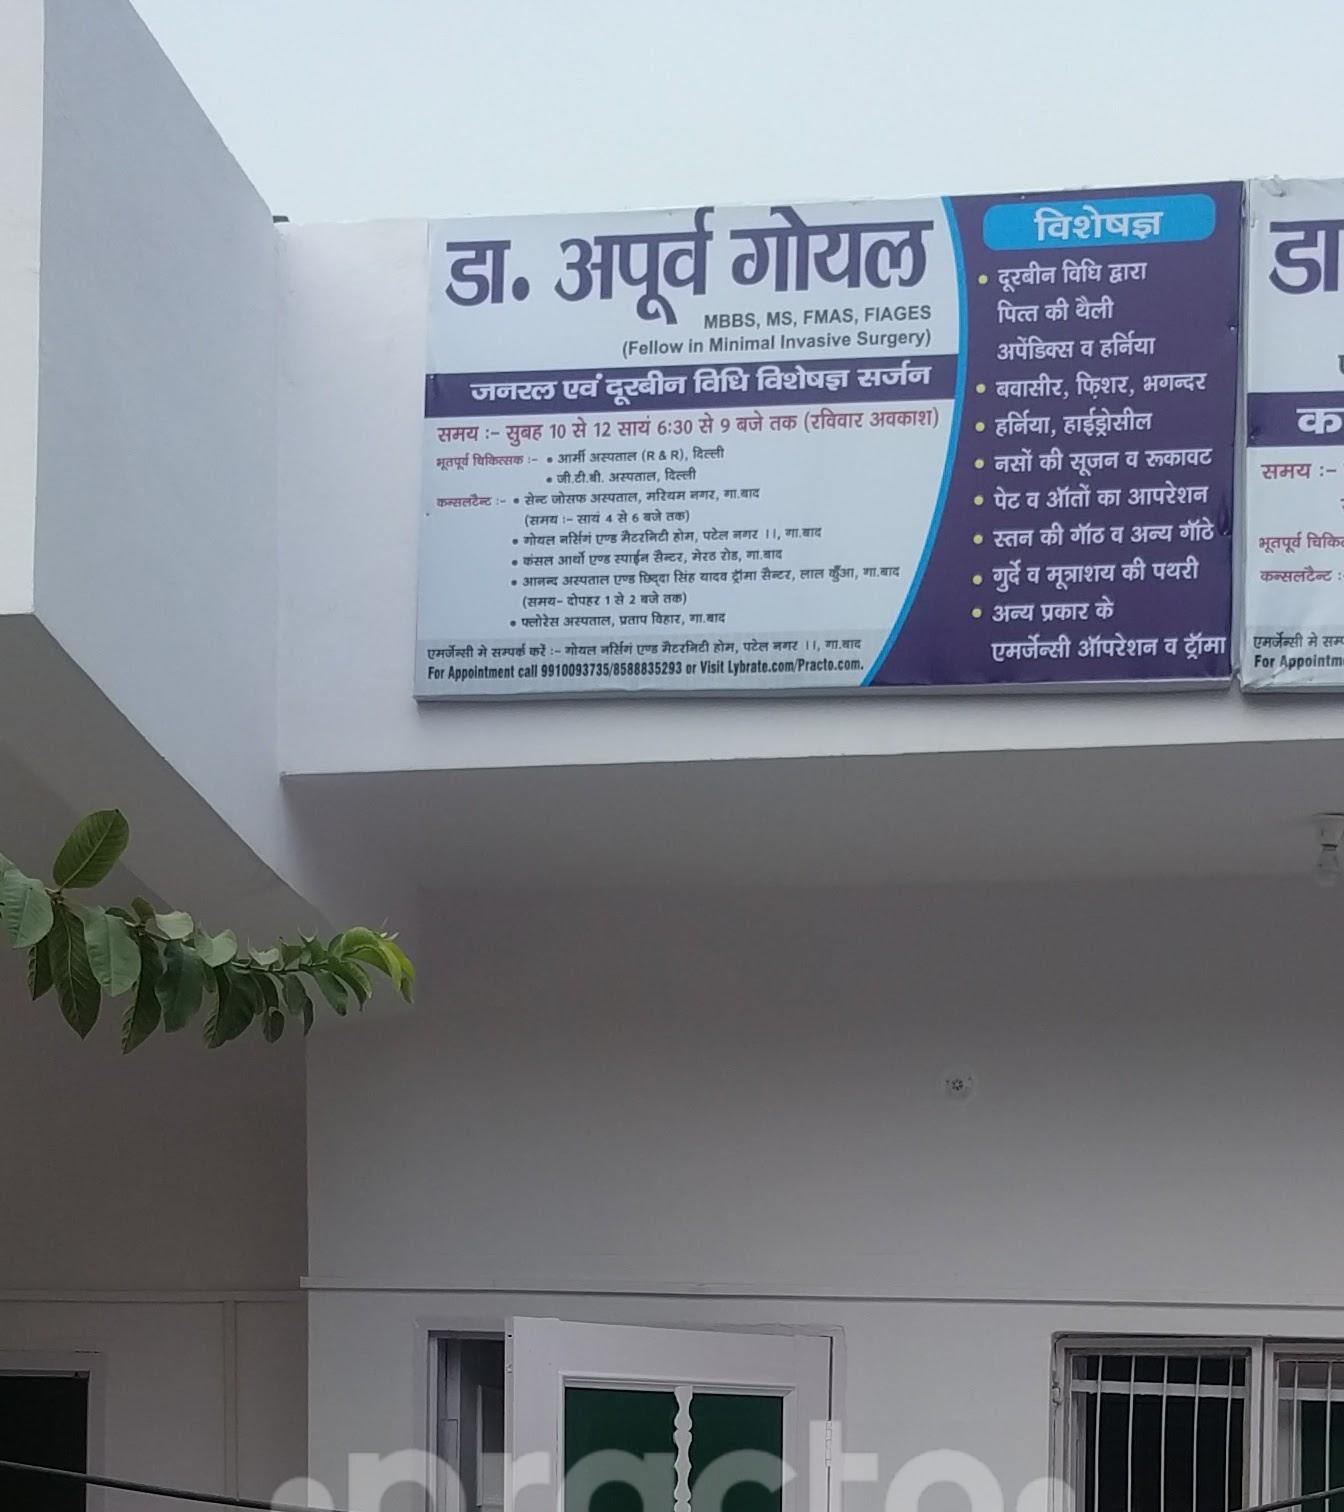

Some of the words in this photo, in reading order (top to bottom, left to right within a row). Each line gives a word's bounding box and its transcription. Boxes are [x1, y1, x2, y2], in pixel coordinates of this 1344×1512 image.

[1034, 204, 1164, 241] विशेषज्ञ
[555, 206, 714, 324] अपूर्व
[730, 206, 934, 291] गोयल
[998, 261, 1056, 292] दूरबीन
[1062, 258, 1102, 282] विधि
[1108, 262, 1148, 283] द्वारा
[1045, 297, 1069, 320] की
[1076, 295, 1114, 319] थैली
[562, 374, 602, 399] एवं
[606, 370, 687, 405] दूरबीन
[694, 368, 750, 393] विधि
[756, 366, 850, 390] विशेषज्ञ
[857, 360, 932, 387] सर्जन
[996, 373, 1068, 399] बवासीर,
[506, 425, 543, 447] सुबह
[572, 417, 587, 438] से
[698, 413, 714, 434] से
[736, 410, 763, 432] बजे
[804, 408, 864, 433] (रविवार
[870, 407, 938, 429] अवकाश)
[995, 410, 1056, 437] हर्निया,
[1095, 595, 1114, 619] के
